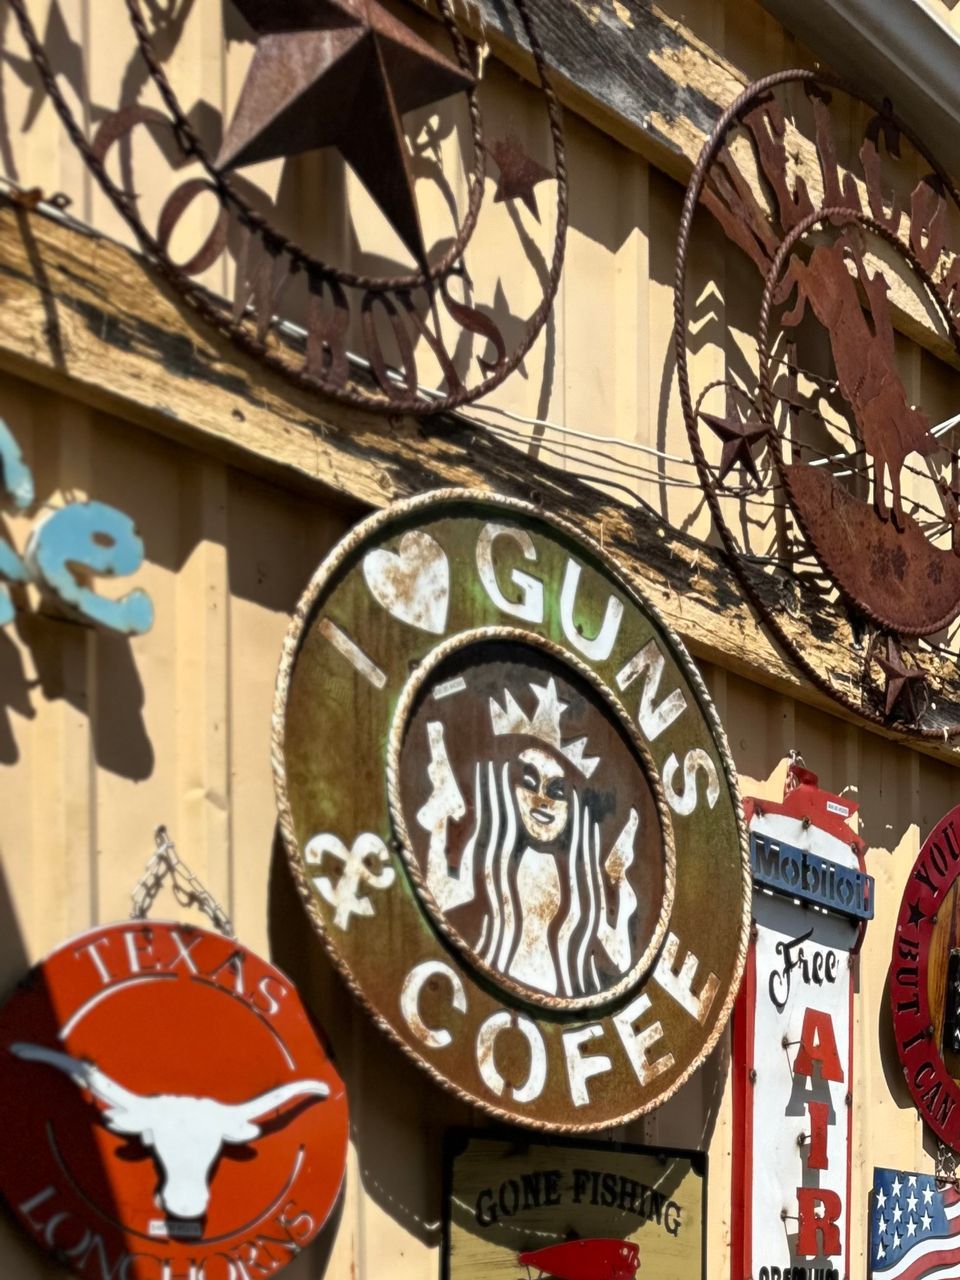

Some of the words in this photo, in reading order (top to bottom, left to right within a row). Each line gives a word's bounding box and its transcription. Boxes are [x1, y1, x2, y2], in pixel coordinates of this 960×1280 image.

[476, 523, 720, 818] GUNS
[755, 836, 870, 912] Mobiloil
[72, 920, 288, 1018] TEXAS
[769, 927, 837, 1008] Free
[895, 937, 920, 1018] BUT
[400, 931, 722, 1109] COFEE
[902, 1028, 926, 1054] I
[794, 1006, 845, 1258] AIR
[912, 1061, 956, 1131] CAN
[475, 1168, 562, 1228] GONE
[571, 1168, 683, 1237] FISHING
